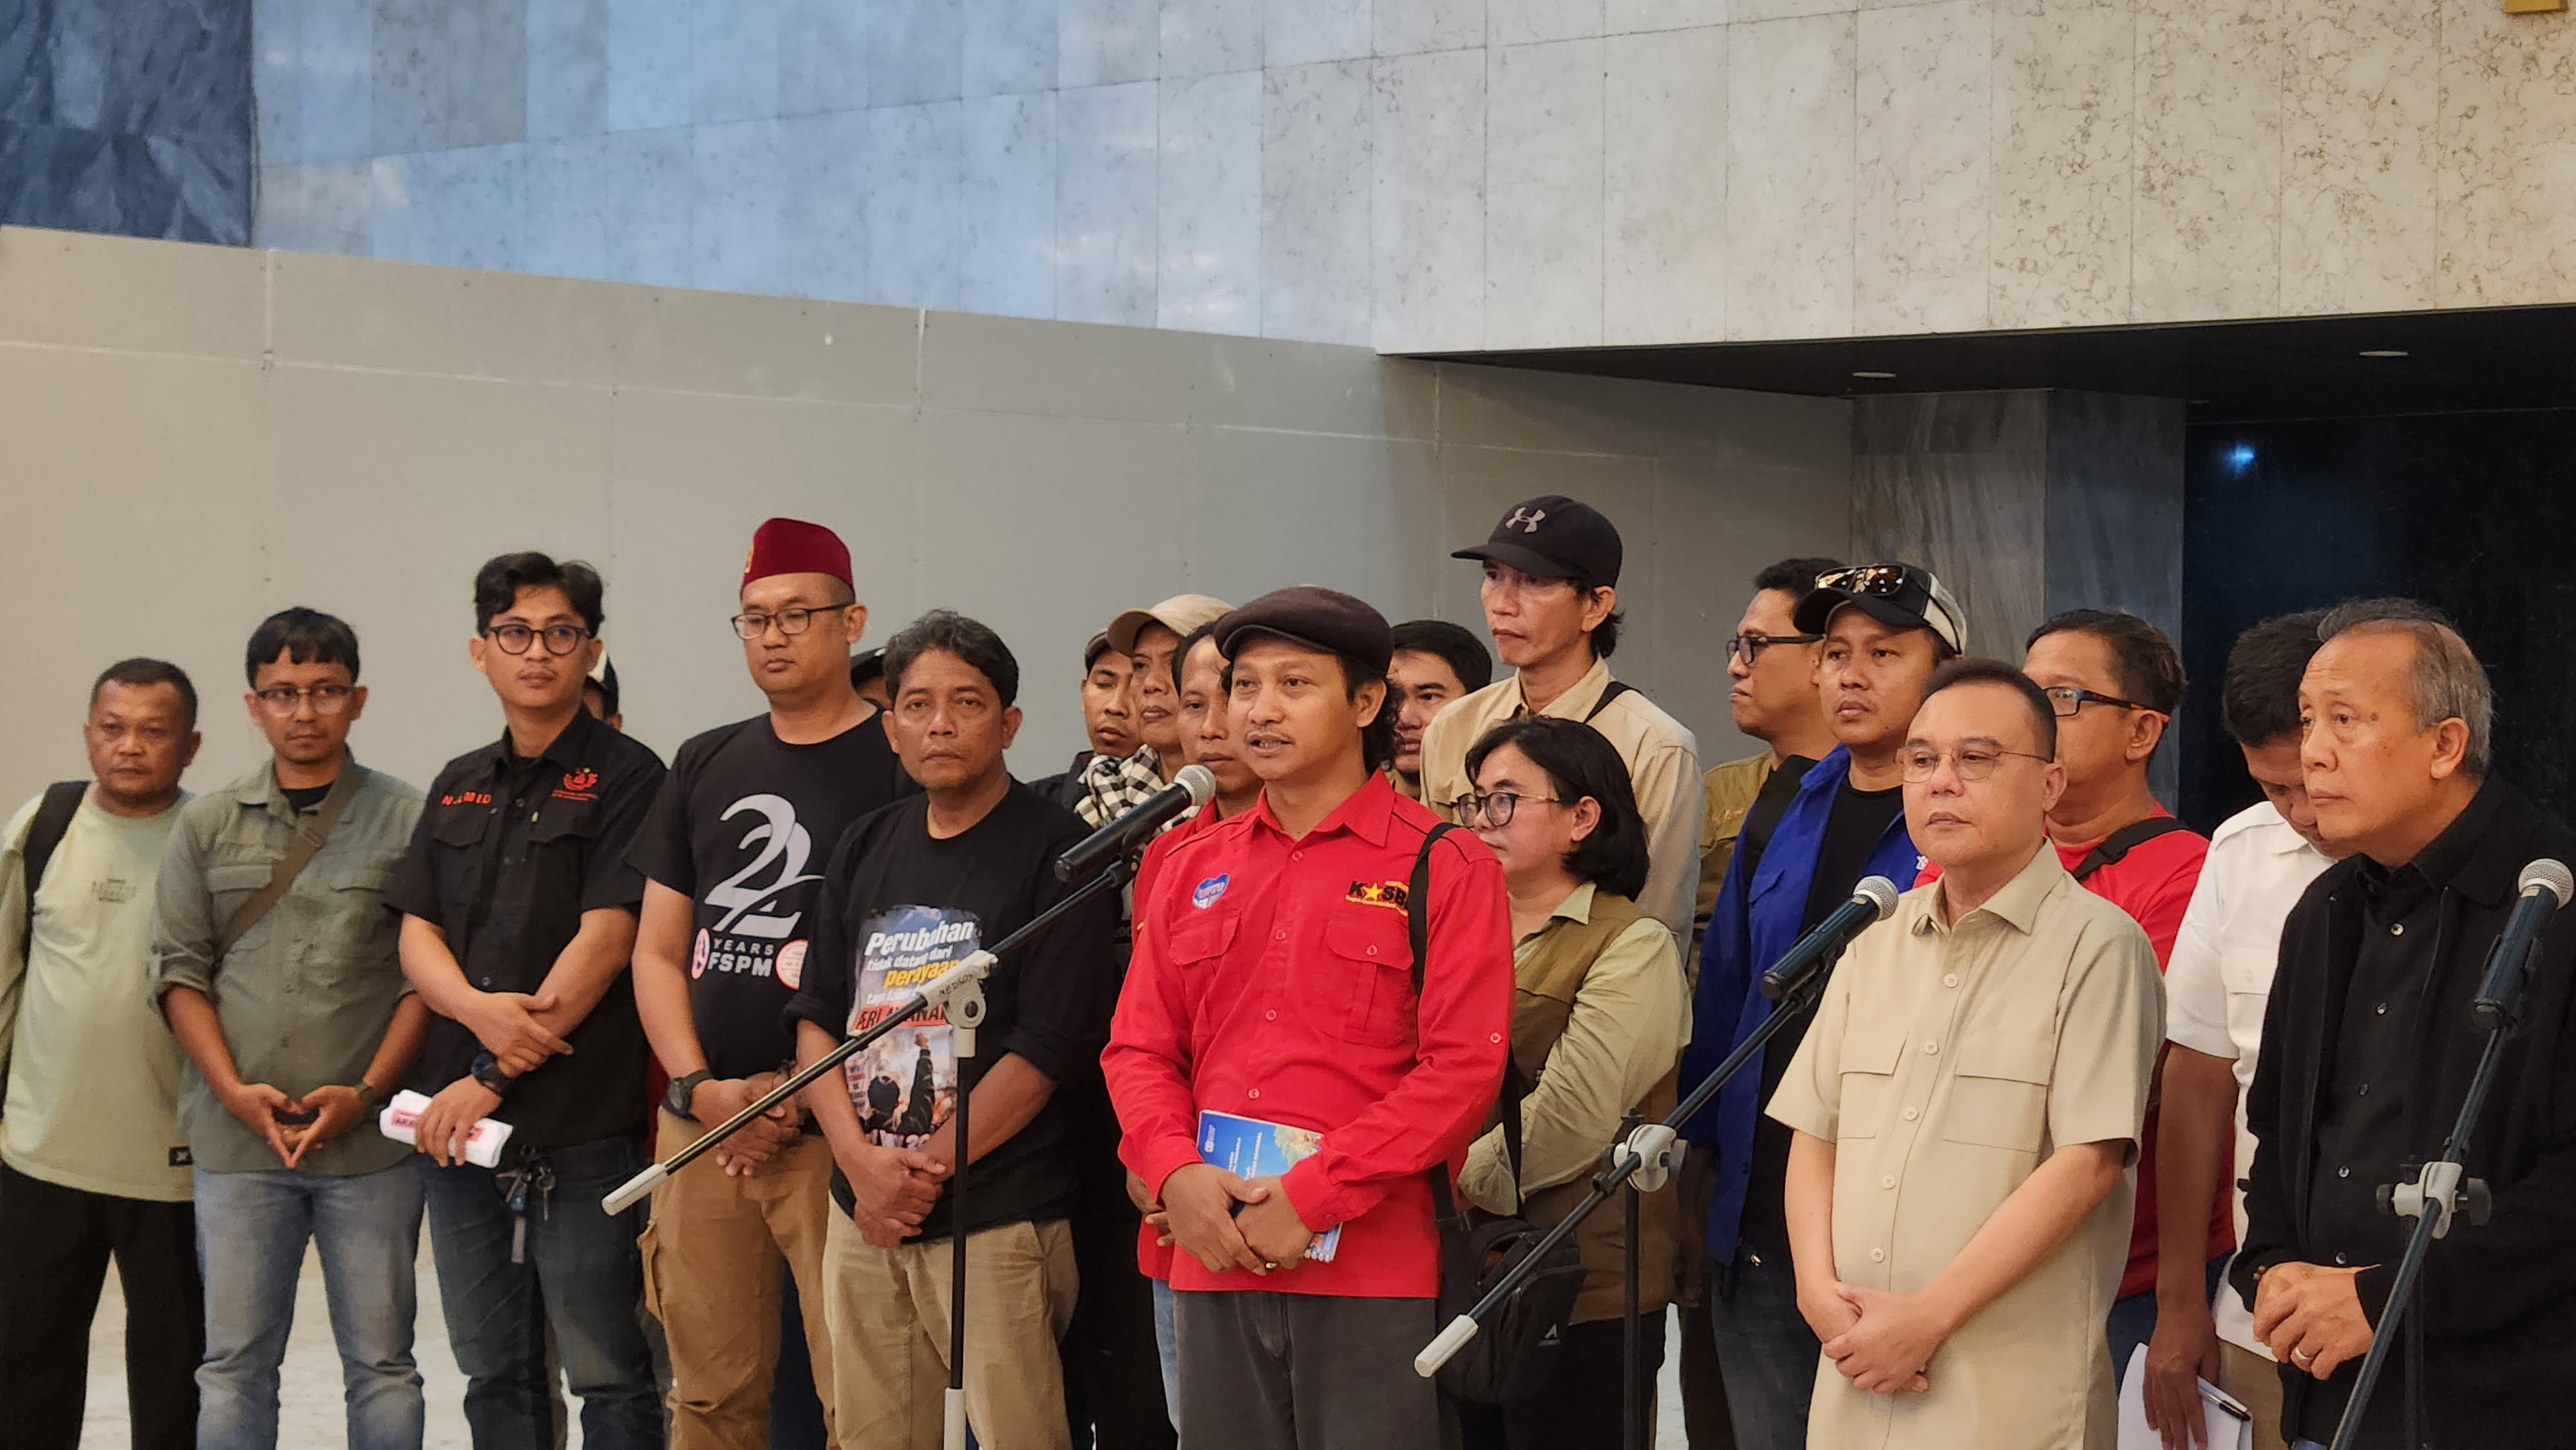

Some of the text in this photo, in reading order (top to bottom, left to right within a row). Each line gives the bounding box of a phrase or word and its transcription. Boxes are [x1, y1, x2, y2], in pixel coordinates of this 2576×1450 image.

[713, 938, 775, 956] YEARS
[864, 919, 976, 957] Perubahan
[707, 952, 773, 977] FSPM
